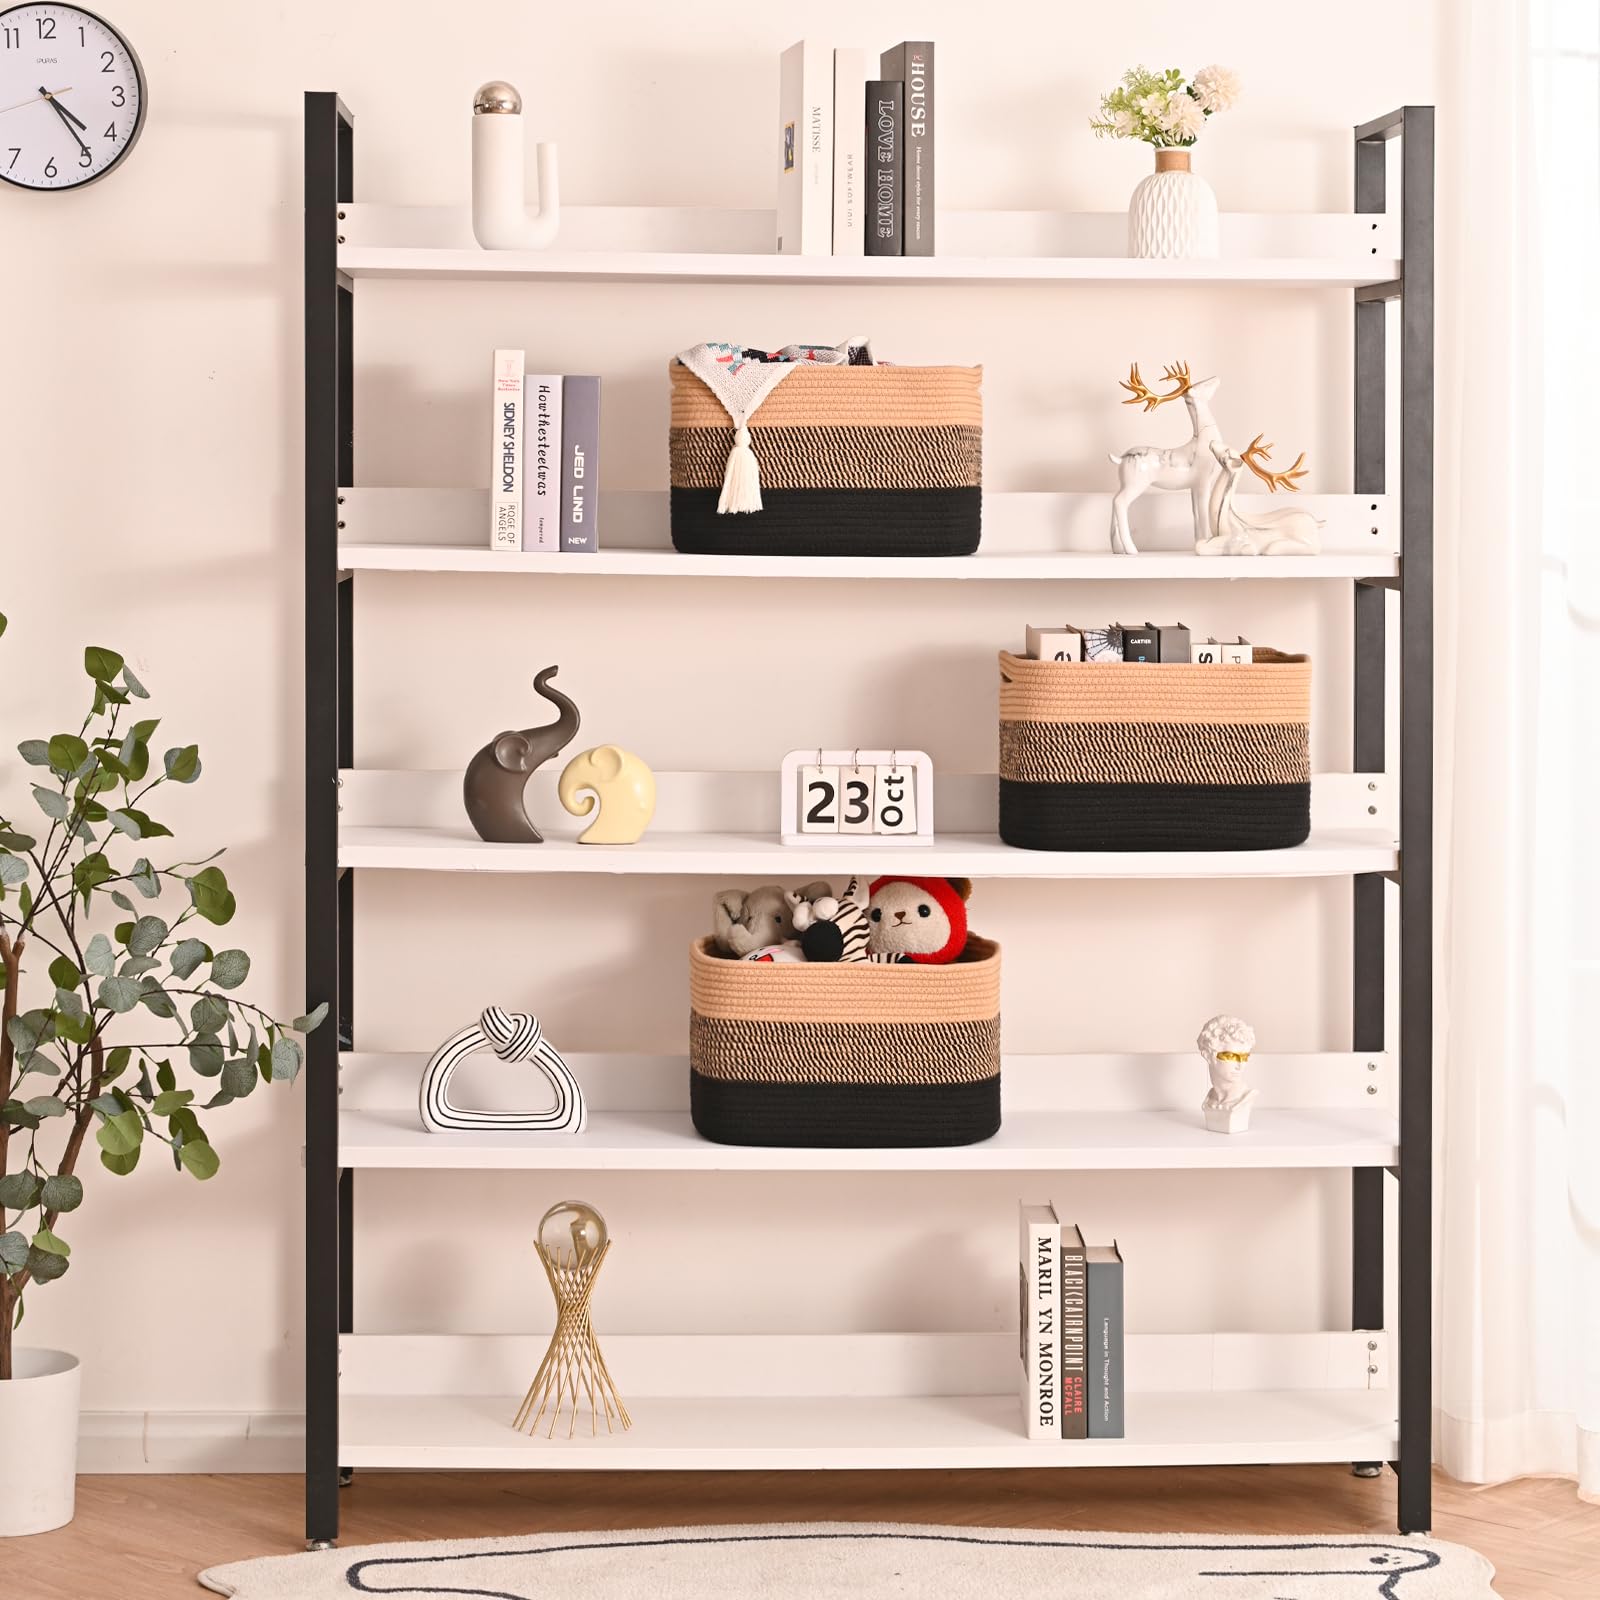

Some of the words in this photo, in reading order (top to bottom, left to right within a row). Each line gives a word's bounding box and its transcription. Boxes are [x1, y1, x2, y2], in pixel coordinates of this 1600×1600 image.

[4, 28, 20, 48] 11
[36, 18, 56, 39] 12
[78, 26, 85, 47] 1
[100, 51, 115, 73] 2
[111, 85, 125, 107] 3
[911, 62, 925, 137] HOUSE
[103, 121, 117, 142] 4
[812, 106, 821, 153] MATISSE
[877, 100, 894, 162] LOVE
[8, 148, 21, 169] 7
[44, 156, 57, 178] 6
[78, 146, 92, 168] 5
[877, 169, 894, 238] HOME
[503, 402, 515, 439] SIDNEY
[503, 441, 515, 493] SHELDON
[574, 445, 585, 479] JED
[573, 485, 584, 523] LIND
[498, 507, 507, 541] ANGELS
[507, 532, 515, 544] OF
[568, 537, 588, 545] NEW
[1038, 1237, 1052, 1300] MARIL
[1038, 1308, 1053, 1334] YN
[1039, 1343, 1054, 1426] MONROE
[1074, 1377, 1082, 1413] CLAIRE
